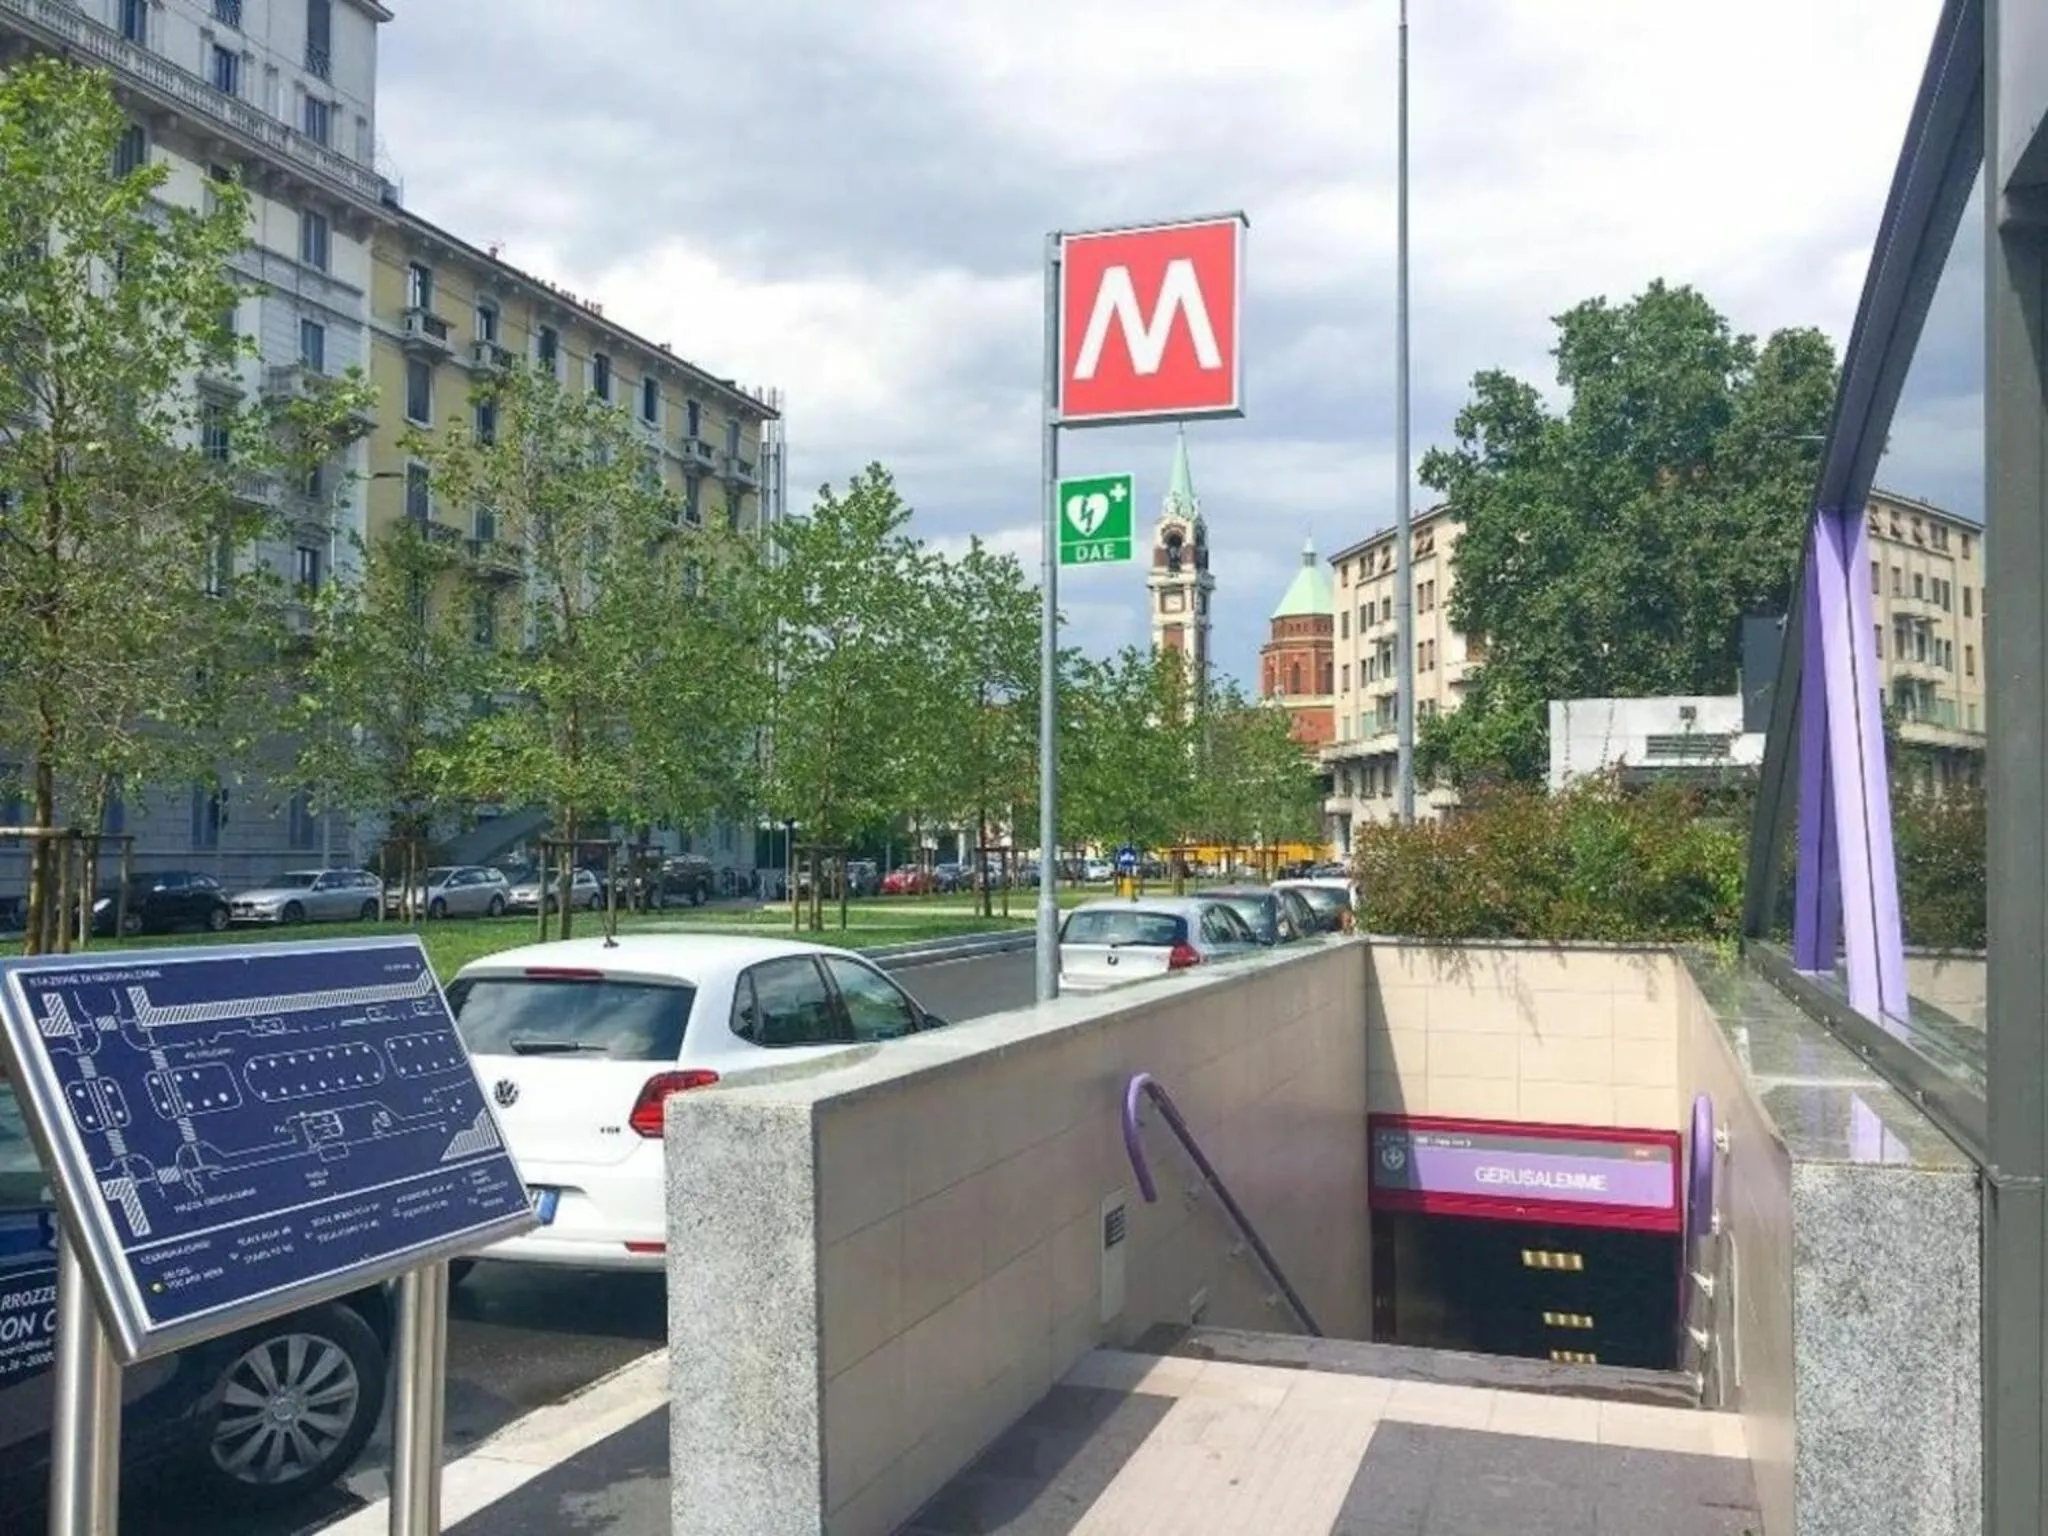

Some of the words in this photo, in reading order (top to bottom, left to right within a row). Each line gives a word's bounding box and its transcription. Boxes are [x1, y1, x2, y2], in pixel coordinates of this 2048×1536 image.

[1072, 257, 1223, 381] M
[1075, 543, 1115, 562] DAE
[1475, 1166, 1609, 1191] GERUSALEMME
